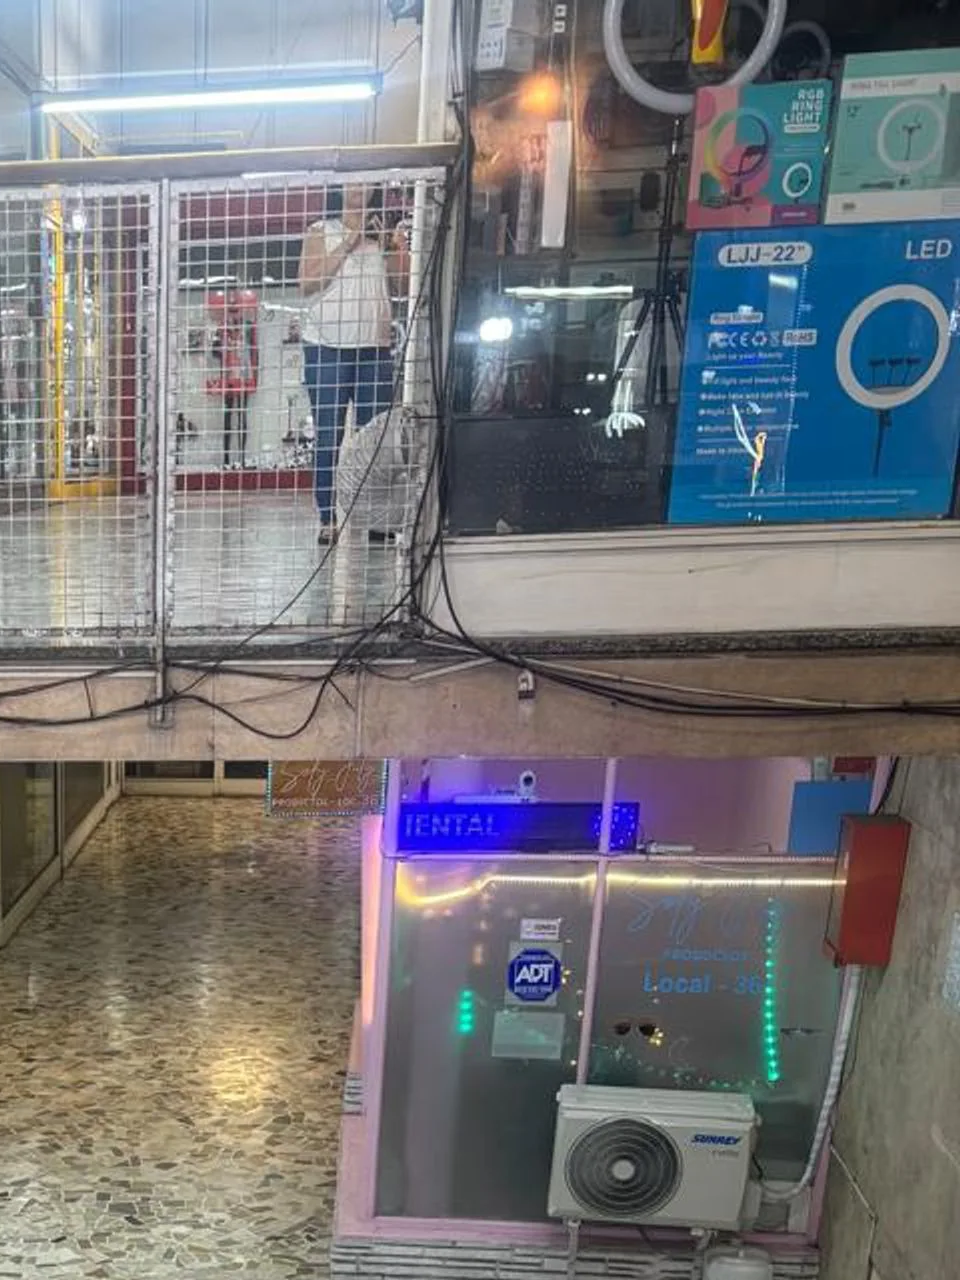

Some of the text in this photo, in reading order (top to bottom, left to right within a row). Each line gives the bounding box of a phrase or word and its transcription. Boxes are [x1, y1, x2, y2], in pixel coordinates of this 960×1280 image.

[798, 89, 824, 99] RGB
[792, 100, 823, 111] RING
[783, 112, 821, 123] LIGHT
[906, 239, 952, 260] LED
[515, 963, 554, 983] ADT
[643, 971, 711, 993] Local
